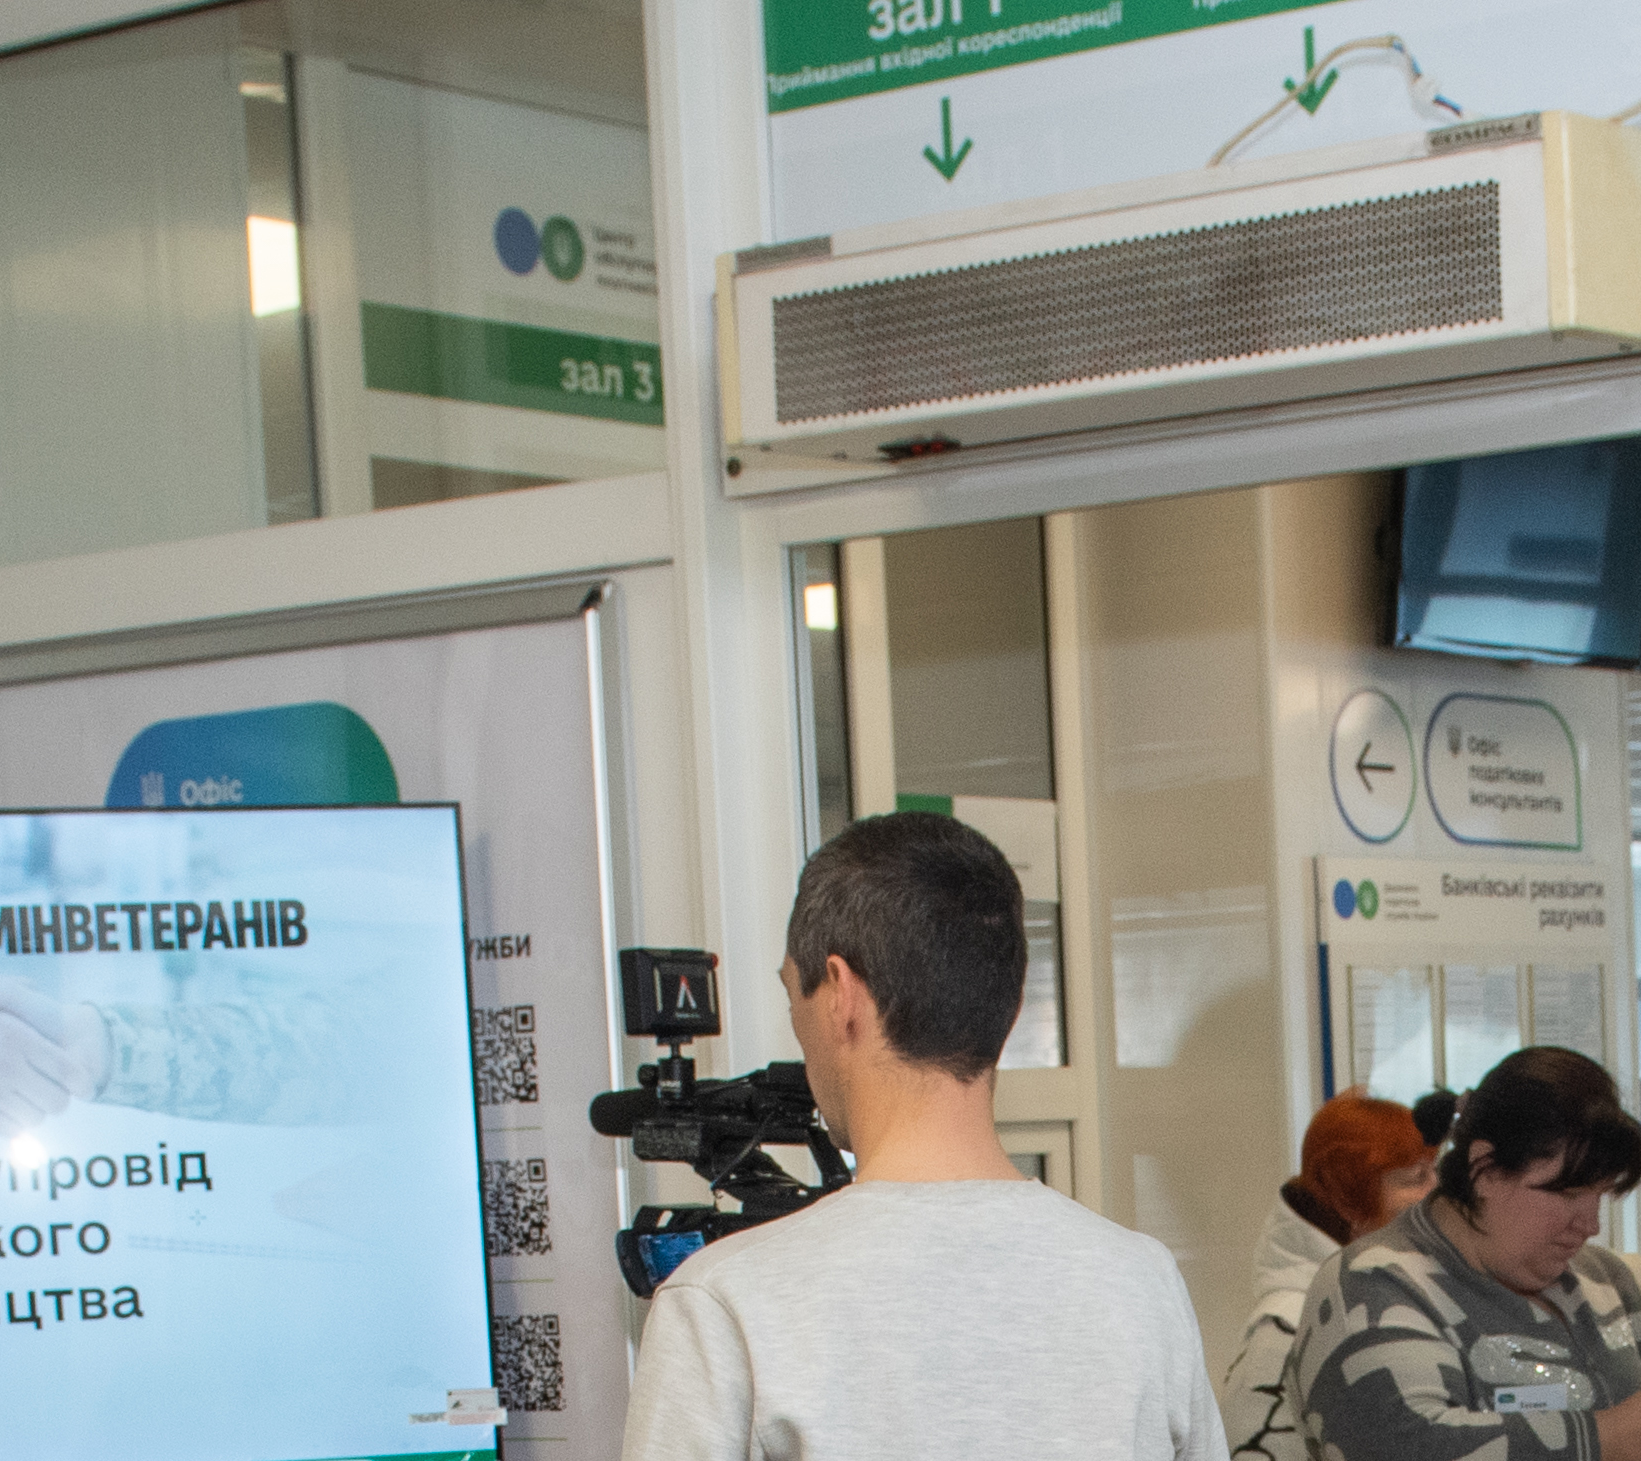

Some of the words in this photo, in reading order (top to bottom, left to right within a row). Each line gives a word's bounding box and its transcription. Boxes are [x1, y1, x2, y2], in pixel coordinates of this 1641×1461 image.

[880, 40, 955, 74] вхідної
[956, 1, 1124, 55] кореспонденції
[560, 357, 624, 398] зал
[633, 360, 655, 403] 3
[1467, 735, 1501, 757] Офіс
[179, 775, 243, 806] Офіс
